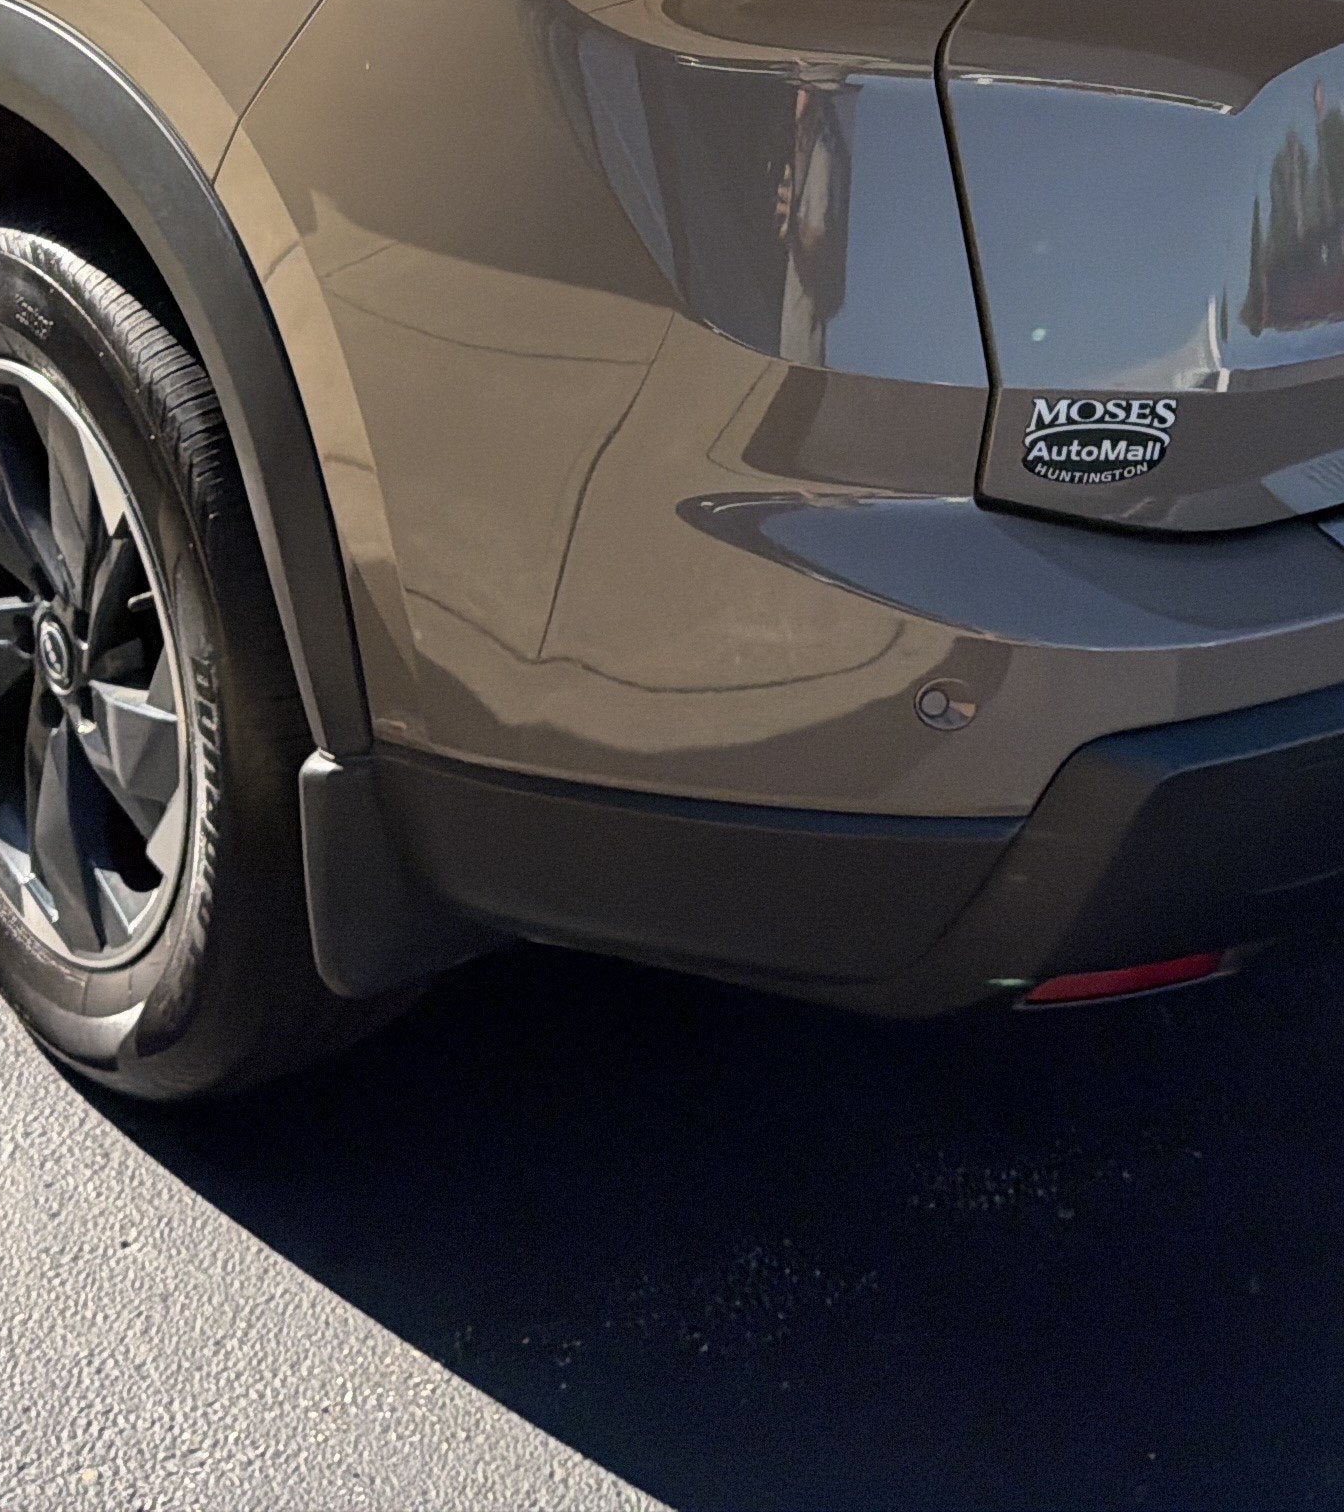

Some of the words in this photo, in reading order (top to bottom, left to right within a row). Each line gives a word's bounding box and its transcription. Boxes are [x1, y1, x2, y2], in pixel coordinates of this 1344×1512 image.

[1025, 398, 1177, 434] MOSES
[1027, 439, 1161, 462] AutoMall
[1035, 461, 1148, 484] HUNTINGTON
